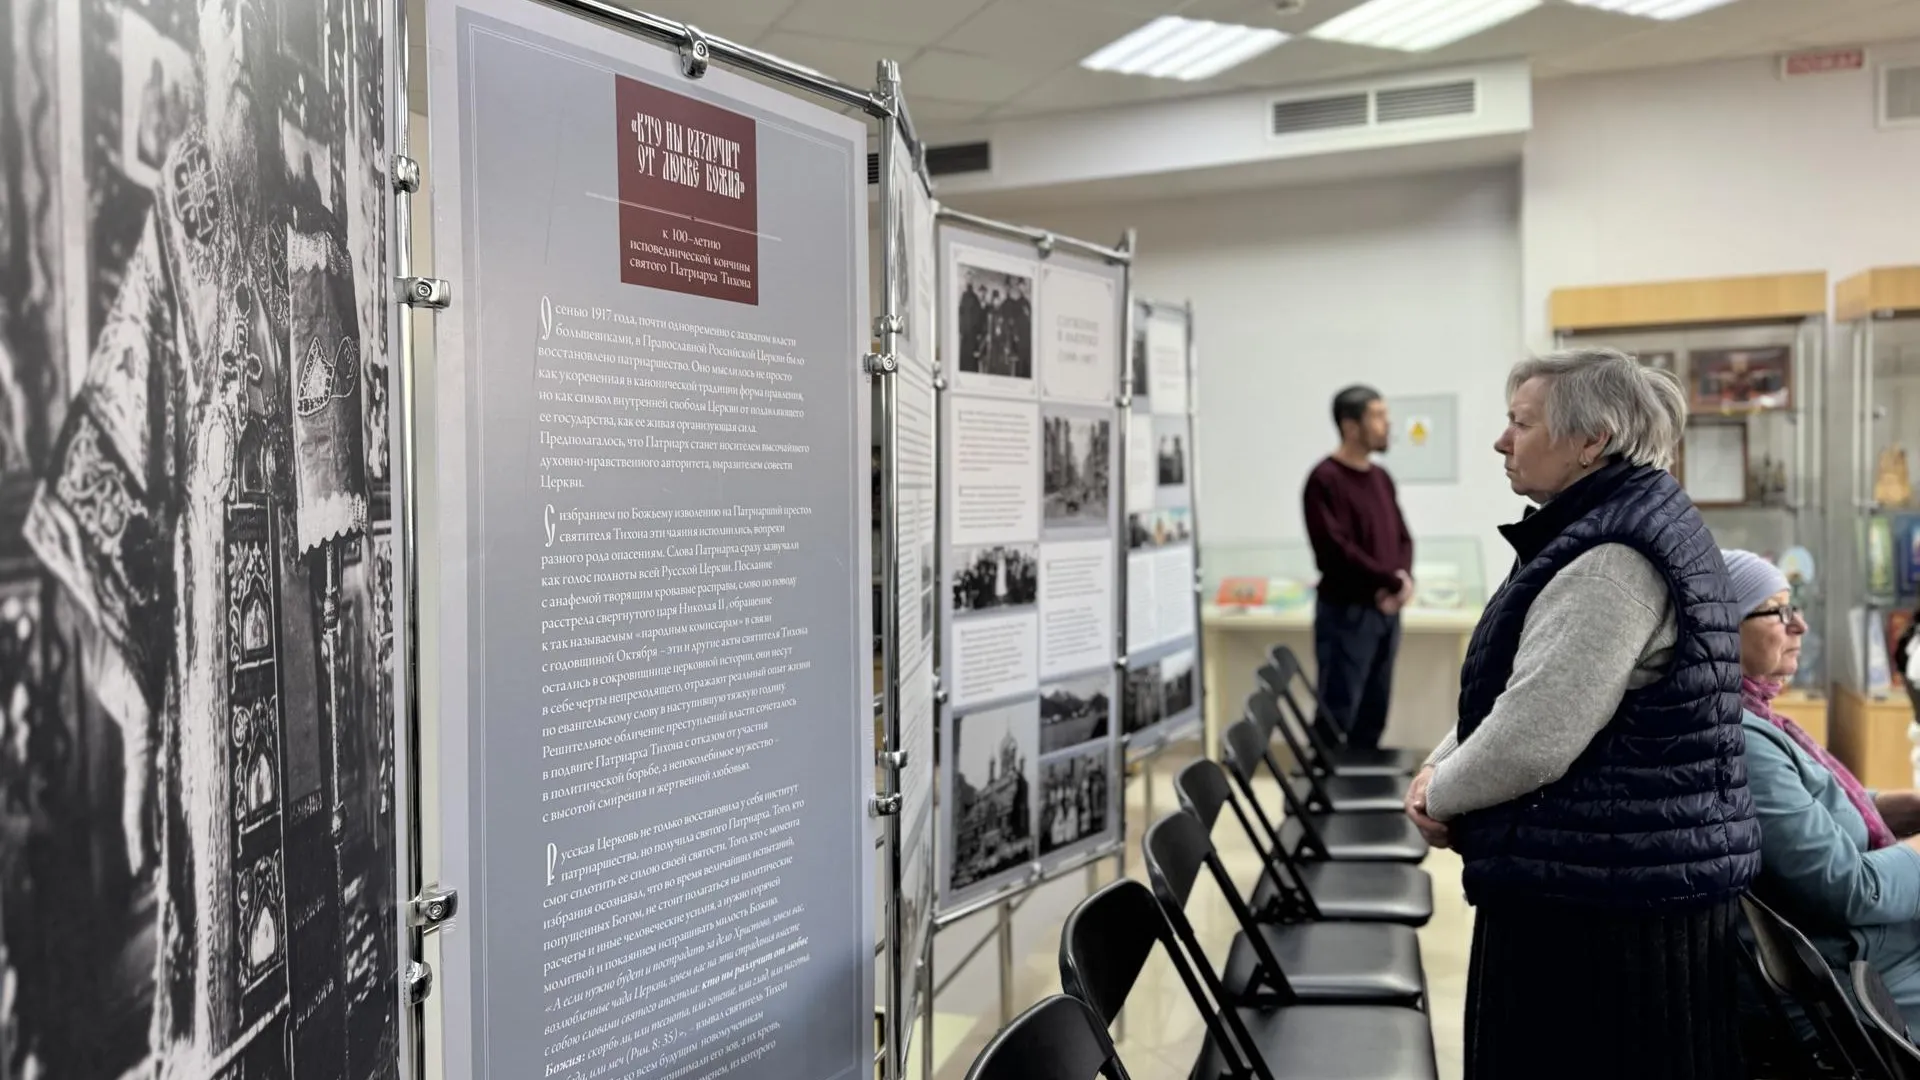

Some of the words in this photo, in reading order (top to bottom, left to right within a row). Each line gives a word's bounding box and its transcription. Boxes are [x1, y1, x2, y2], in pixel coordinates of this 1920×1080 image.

[666, 121, 682, 153] НЫ
[688, 128, 740, 169] РАЗЛУЧИТ
[638, 144, 655, 176] ОТ
[662, 151, 700, 188] ЛЮБВЕ
[662, 229, 668, 239] к
[630, 240, 710, 264] исповеднической
[714, 257, 750, 272] кончины
[630, 258, 667, 272] святого
[671, 262, 718, 284] Патриарха
[720, 271, 751, 289] Тихона
[592, 307, 611, 320] 1917
[538, 347, 615, 363] восстановлено
[538, 368, 559, 379] как
[560, 371, 625, 386] укорененная
[538, 391, 552, 400] но
[555, 392, 573, 402] как
[574, 394, 611, 404] символ
[539, 413, 551, 422] ее
[618, 417, 633, 426] как
[635, 418, 645, 427] ее
[627, 438, 643, 447] что
[540, 457, 659, 471] духовно-нравственного
[559, 507, 615, 525] избранием
[617, 511, 629, 519] по
[559, 531, 611, 542] святителя
[612, 527, 647, 539] Тихона
[541, 554, 583, 569] разного
[585, 552, 609, 566] рода
[541, 576, 560, 586] как
[562, 574, 591, 584] голос
[593, 571, 636, 582] полноты
[639, 567, 659, 578] всей
[549, 592, 601, 610] анафемой
[603, 590, 652, 604] творящим
[542, 615, 594, 634] расстрела
[596, 609, 655, 626] свергнутого
[550, 639, 568, 650] так
[570, 632, 632, 647] называемым
[550, 652, 614, 671] годовщиной
[616, 645, 656, 661] Октября
[542, 679, 590, 693] остались
[550, 698, 574, 713] себе
[575, 696, 607, 712] черты
[542, 726, 556, 736] по
[558, 712, 631, 733] евангельскому
[633, 707, 658, 719] слову
[543, 736, 612, 758] Решительное
[550, 761, 593, 778] подвиге
[595, 748, 647, 768] Патриарха
[550, 772, 624, 799] политической
[550, 800, 595, 820] высотой
[597, 789, 646, 808] смирения
[597, 831, 638, 850] Церковь
[640, 827, 650, 838] не
[640, 846, 652, 857] но
[543, 893, 568, 908] смог
[570, 878, 616, 899] сплотить
[618, 874, 628, 884] ее
[630, 864, 659, 880] силою
[543, 906, 592, 929] избрания
[543, 920, 610, 950] попущенных
[543, 949, 585, 976] расчеты
[596, 936, 621, 953] иные
[544, 964, 594, 993] молитвой
[605, 944, 656, 970] покаянием
